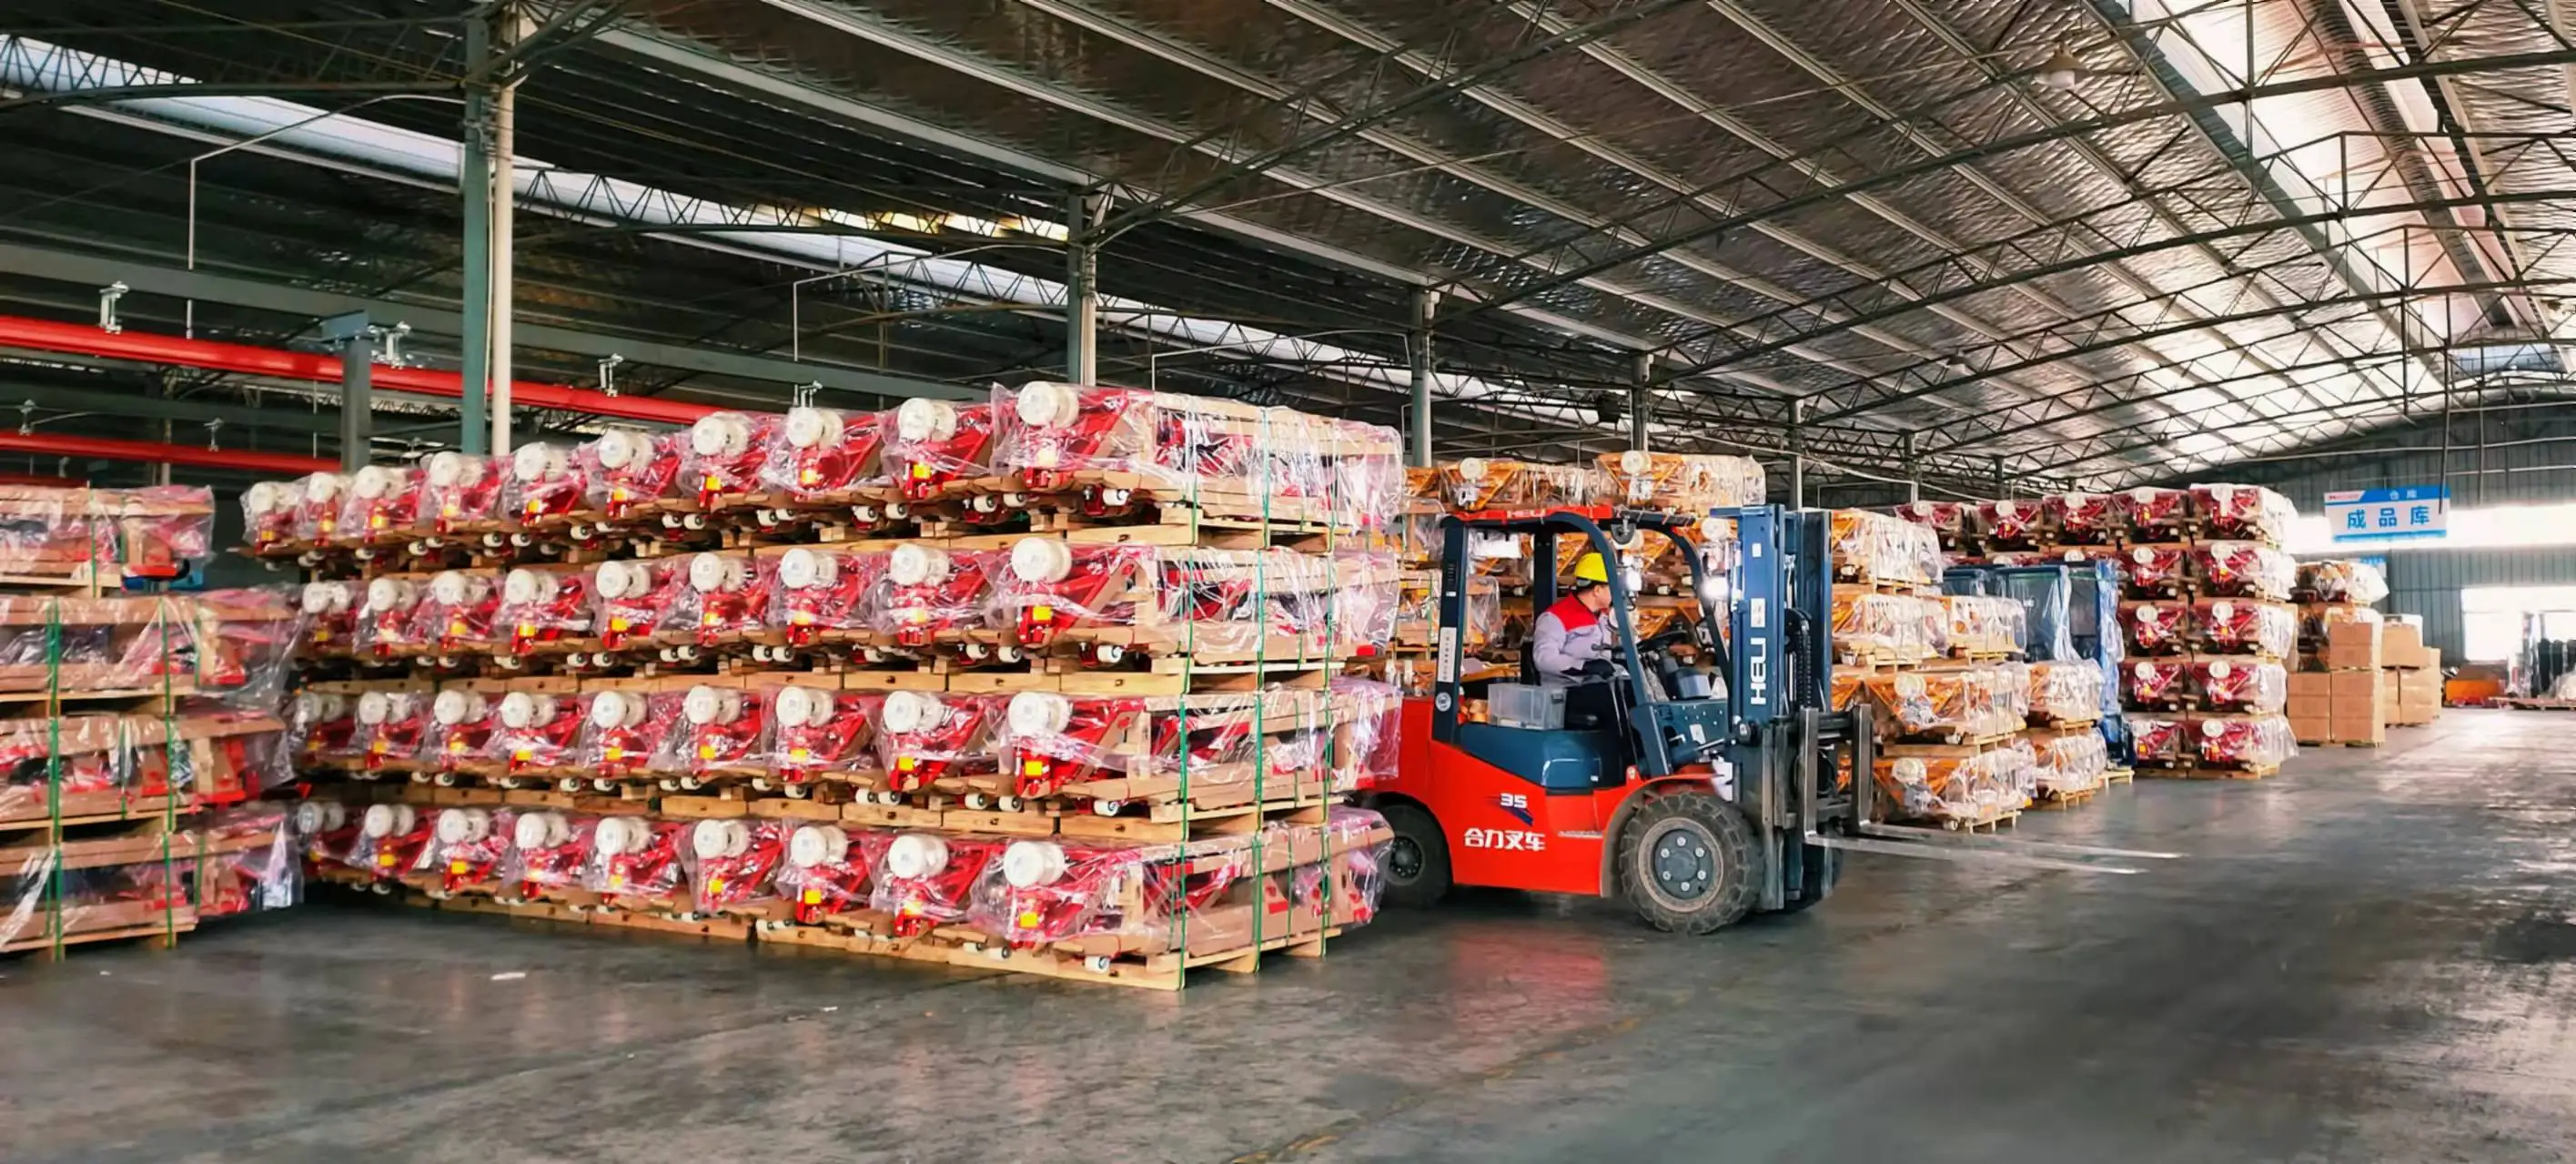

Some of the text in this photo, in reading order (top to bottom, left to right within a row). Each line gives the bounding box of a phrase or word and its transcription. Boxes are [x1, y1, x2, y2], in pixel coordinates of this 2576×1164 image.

[2347, 506, 2430, 530] 成品库
[1750, 637, 1766, 704] HELI
[1500, 793, 1528, 808] 35
[1464, 827, 1546, 852] 合力叉车
